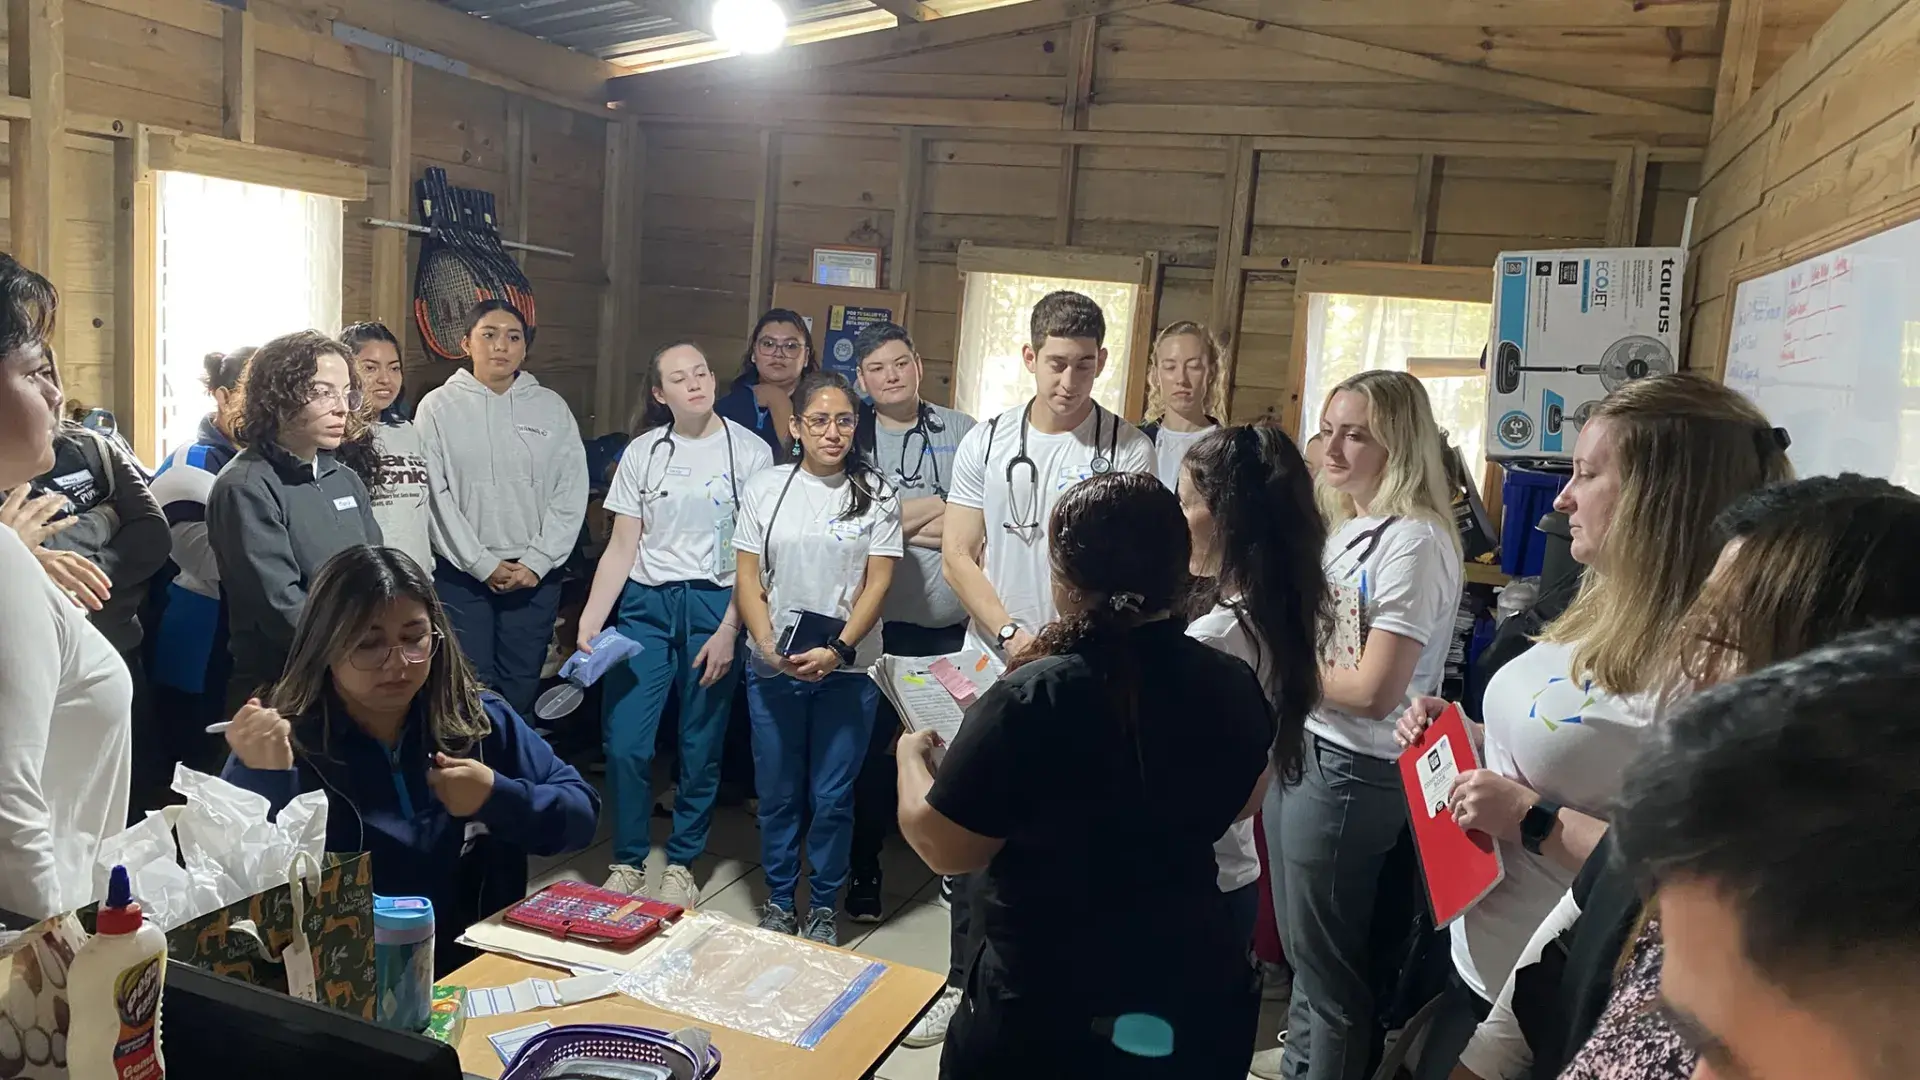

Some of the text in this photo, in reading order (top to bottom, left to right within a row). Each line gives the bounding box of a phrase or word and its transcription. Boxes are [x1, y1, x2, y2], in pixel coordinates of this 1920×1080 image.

[1594, 260, 1610, 308] ECOJET
[1658, 257, 1675, 334] taurus
[123, 1052, 155, 1078] Goma
